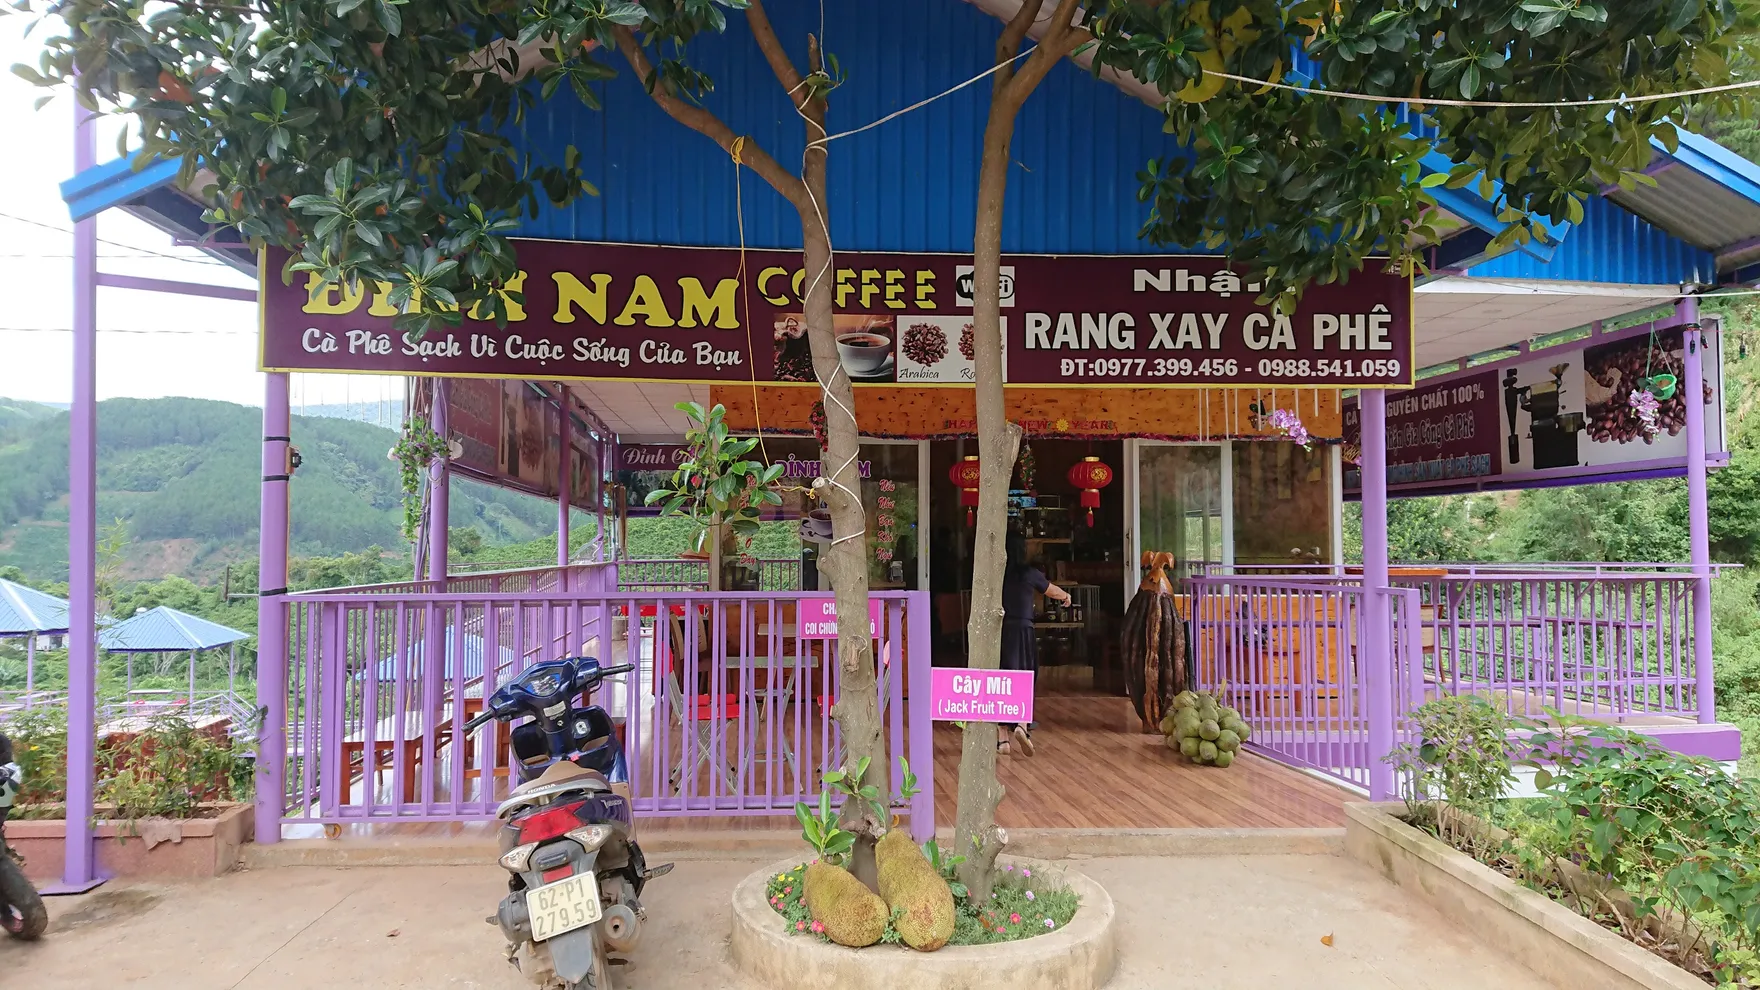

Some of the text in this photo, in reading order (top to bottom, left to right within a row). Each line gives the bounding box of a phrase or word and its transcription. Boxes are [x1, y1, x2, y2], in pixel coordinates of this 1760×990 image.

[551, 271, 740, 329] NAM
[1025, 312, 1135, 350] RANG
[1148, 312, 1229, 350] XAY
[1313, 304, 1392, 350] PHÊ
[302, 327, 743, 372] Cà Phê Sạch Vì Cuộc Sống Của Bạn
[899, 367, 940, 379] Arabica
[1060, 358, 1238, 377] ĐT:0977.399.456
[1258, 358, 1401, 378] 0988.541.059
[1386, 396, 1420, 418] GUYÊN
[1421, 385, 1449, 412] CHẤT
[1452, 383, 1485, 405] 100%
[622, 448, 667, 465] Đỉnh
[805, 622, 817, 635] COI
[952, 675, 1012, 697] Cây Mít
[944, 701, 968, 714] Jack
[971, 701, 995, 715] Fruit
[997, 702, 1019, 715] Tree
[537, 878, 585, 911] 62-P1
[535, 898, 597, 937] 279.59
